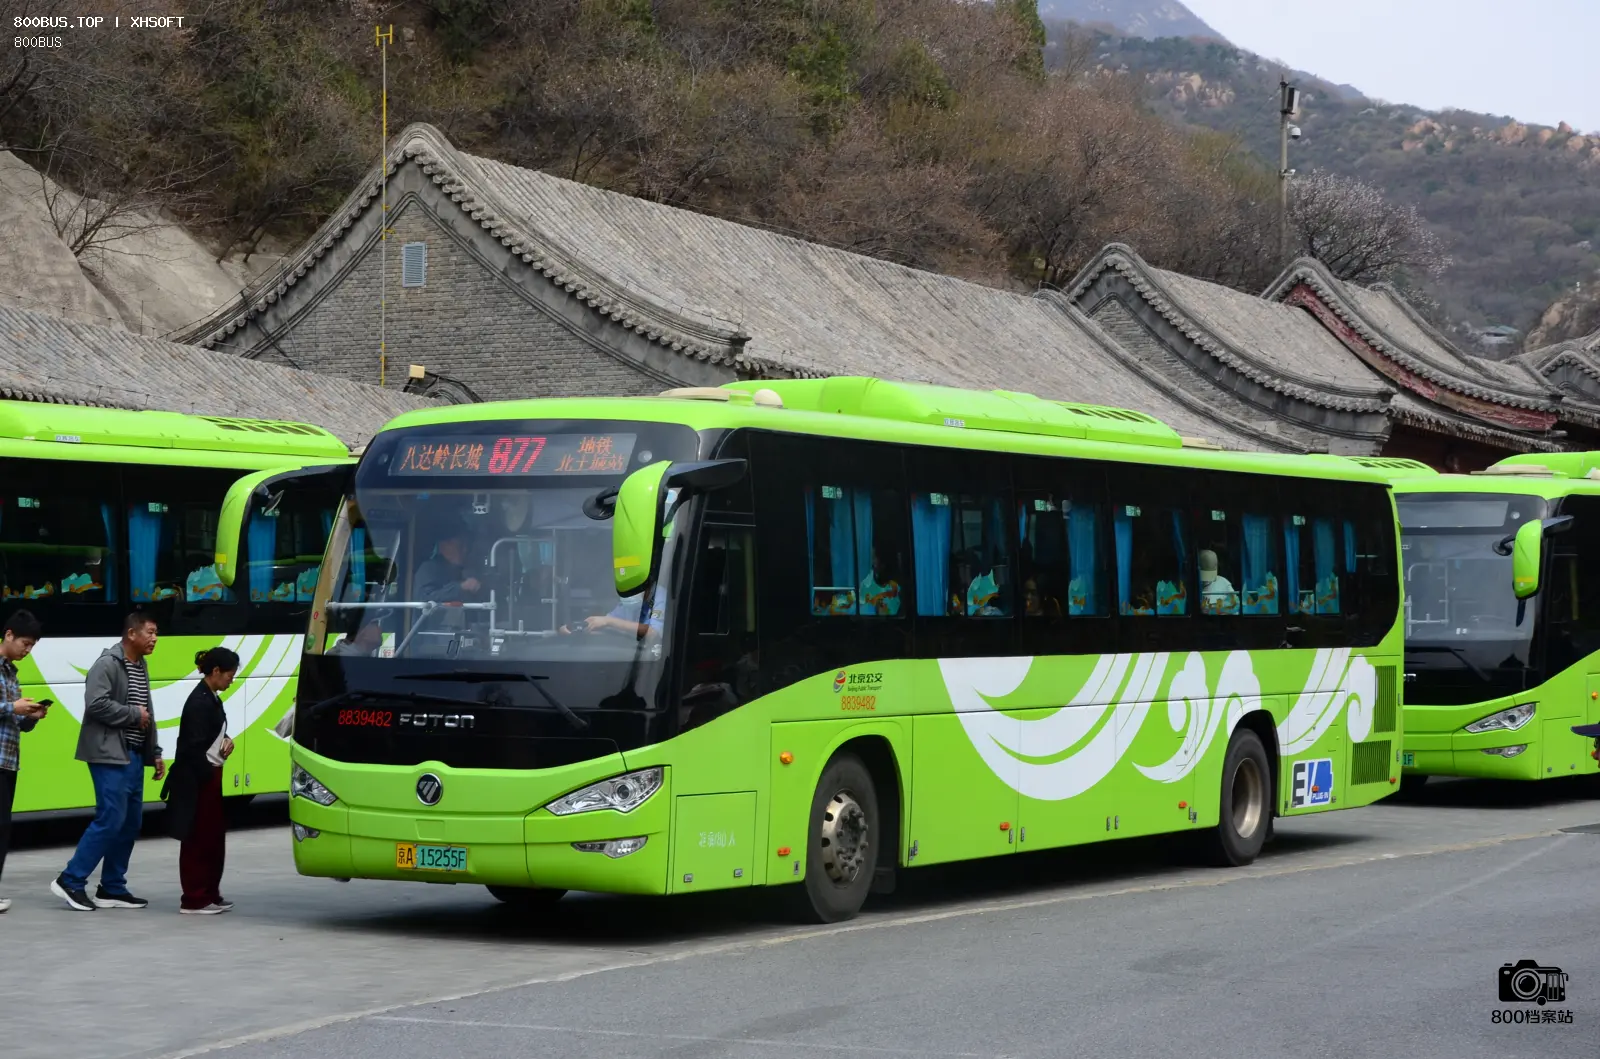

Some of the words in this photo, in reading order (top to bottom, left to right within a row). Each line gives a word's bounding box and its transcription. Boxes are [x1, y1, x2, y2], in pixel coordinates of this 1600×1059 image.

[577, 436, 613, 456] 地铁
[400, 443, 484, 471] 八达岭长城
[488, 437, 547, 473] 877
[848, 673, 883, 684] 北京公交
[841, 695, 876, 711] 8839482
[338, 709, 393, 727] 8839482
[399, 713, 475, 728] FOTON
